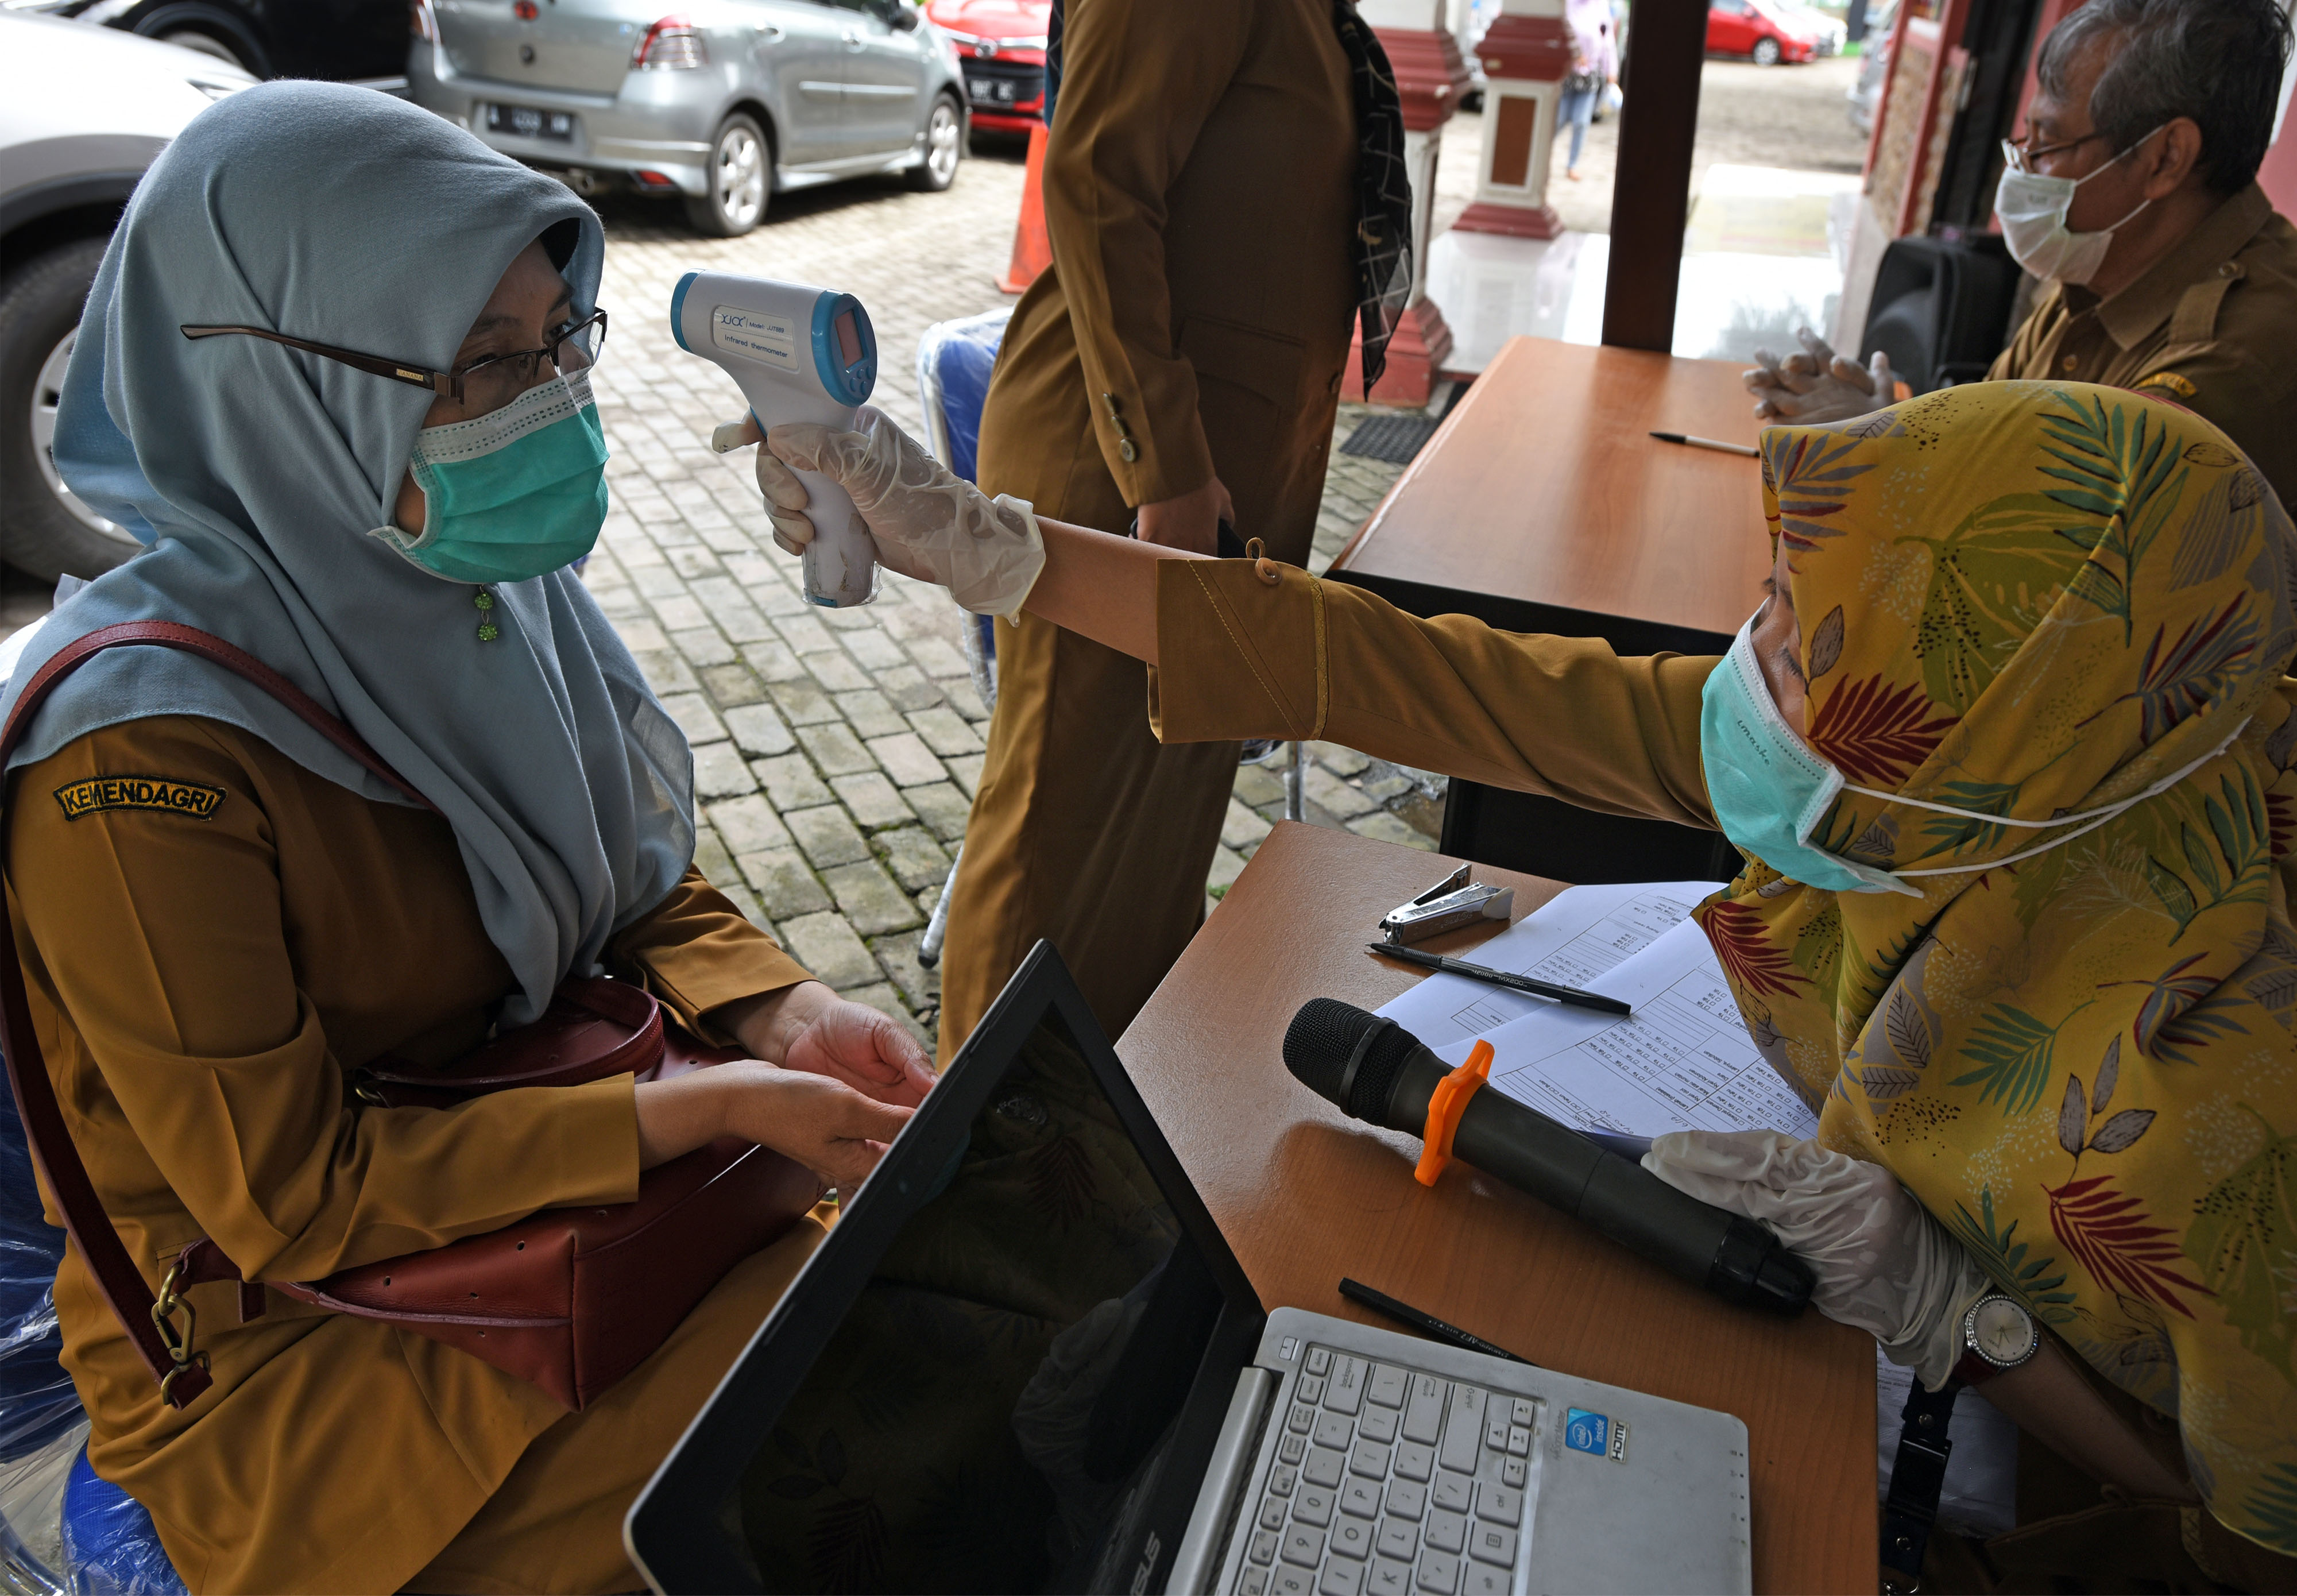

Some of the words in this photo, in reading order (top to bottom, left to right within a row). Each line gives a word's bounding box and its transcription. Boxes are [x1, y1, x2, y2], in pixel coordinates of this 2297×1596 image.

[725, 334, 748, 346] Infrared
[751, 343, 788, 358] thermometer
[64, 780, 215, 813] KEMENDAGRI
[1703, 1050, 1722, 1063] Sebutkan
[1688, 1068, 1708, 1081] Abdomen
[1716, 1072, 1729, 1081] Diare
[1755, 1066, 1766, 1075] Tahu
[1674, 1072, 1689, 1083] muntah
[1706, 1079, 1719, 1088] Nyeri
[1745, 1074, 1756, 1083] Tahu
[1697, 1087, 1709, 1095] Mual
[1735, 1081, 1747, 1089] Tahu
[1687, 1092, 1700, 1102] Nyeri
[1726, 1088, 1737, 1097] Tahu
[1673, 1098, 1689, 1110] Lemah
[1705, 1099, 1722, 1111] Demam
[1716, 1096, 1727, 1104] Tahu
[1720, 1109, 1739, 1122] Riwayat
[1339, 1357, 1354, 1388] backspace
[1422, 1379, 1430, 1396] enter
[1464, 1394, 1473, 1409] shift
[1594, 1417, 1604, 1443] inside
[1577, 1427, 1587, 1446] intel
[1612, 1421, 1625, 1460] HDMI
[1354, 1489, 1366, 1500] P
[1496, 1494, 1504, 1508] ctrl
[1382, 1571, 1397, 1584] K
[1284, 1579, 1299, 1590] 8
